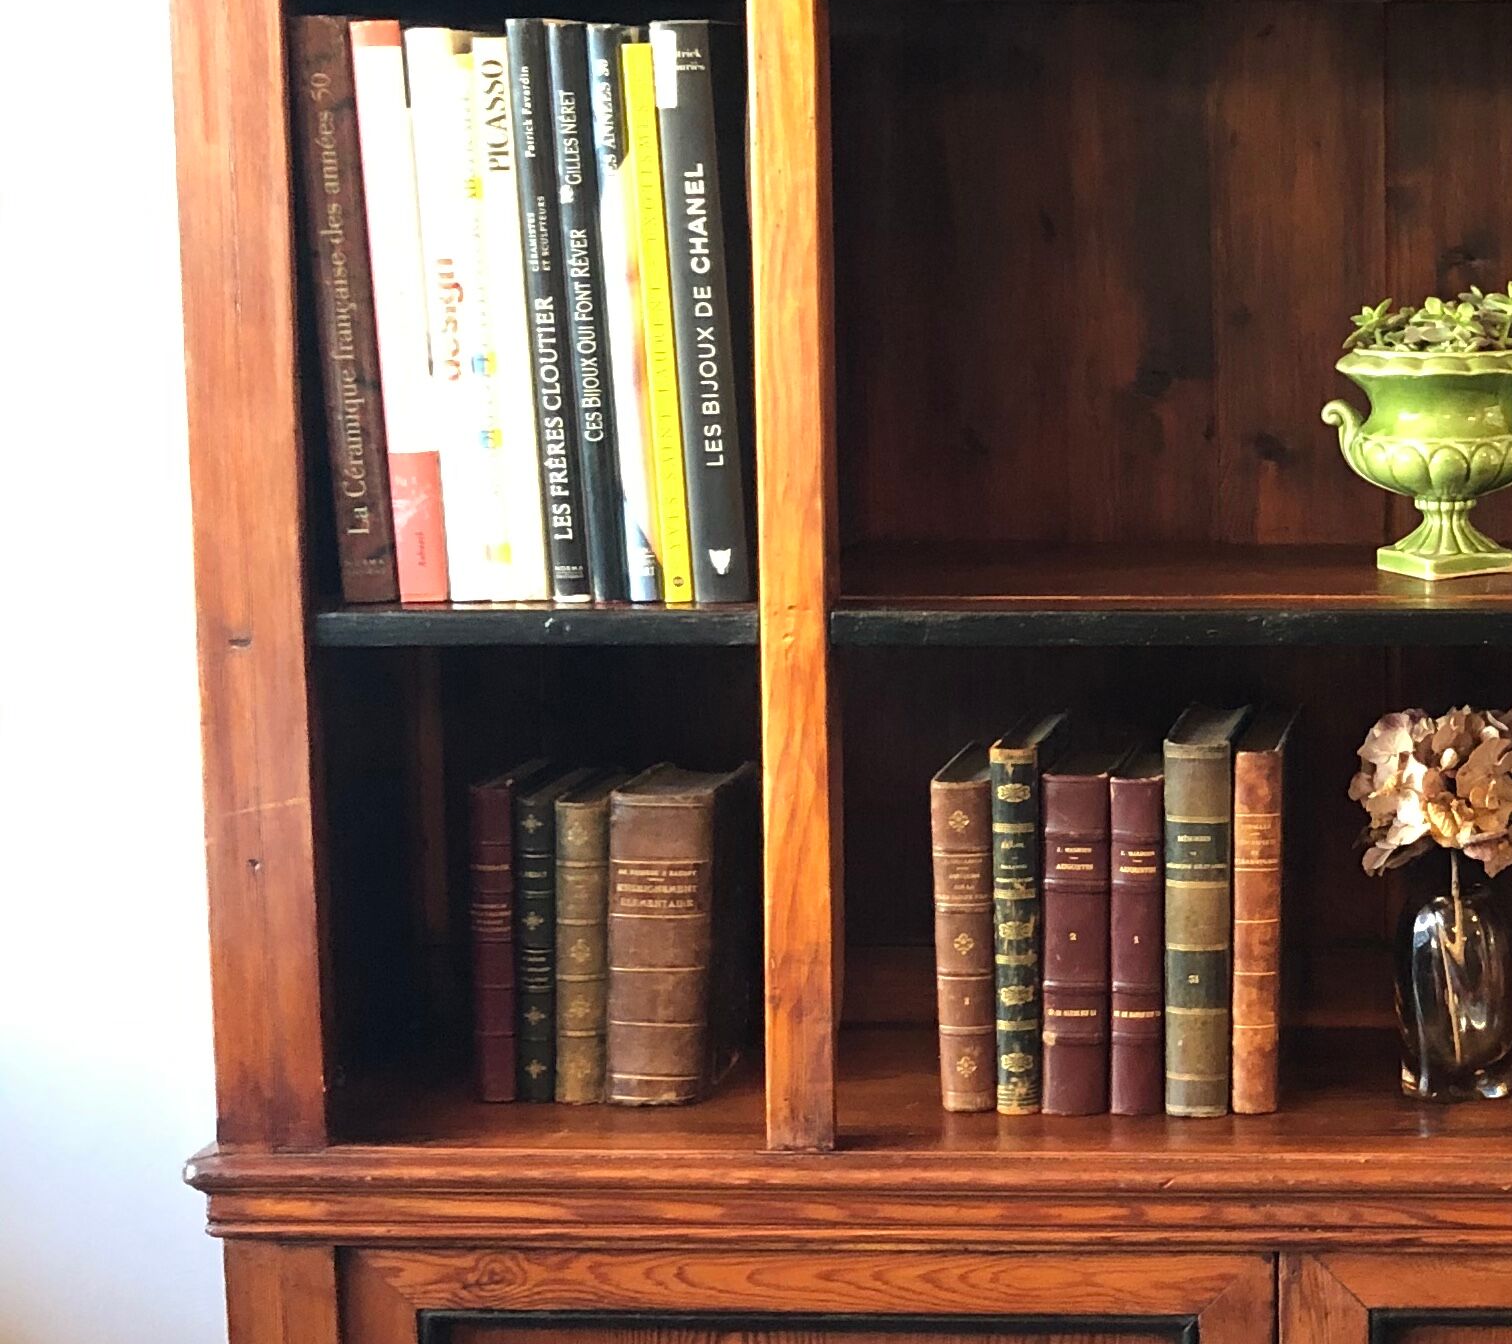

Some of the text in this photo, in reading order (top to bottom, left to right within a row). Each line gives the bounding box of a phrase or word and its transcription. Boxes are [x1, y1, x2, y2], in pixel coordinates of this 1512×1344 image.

[310, 72, 332, 103] 50
[481, 59, 510, 171] PICASSO
[519, 65, 537, 158] Patrick Favardin
[315, 109, 341, 194] années
[559, 89, 583, 186] GILLES NÉRET
[320, 202, 344, 245] des
[328, 251, 357, 361] française
[534, 295, 562, 413] CLOUTIER
[567, 228, 605, 443] CES BIJOUX QUI FONT RÊVER
[683, 162, 725, 467] LES BIJOUX DE CHANEL
[342, 368, 368, 498] Céramique
[347, 506, 370, 535] La
[552, 501, 574, 541] LES
